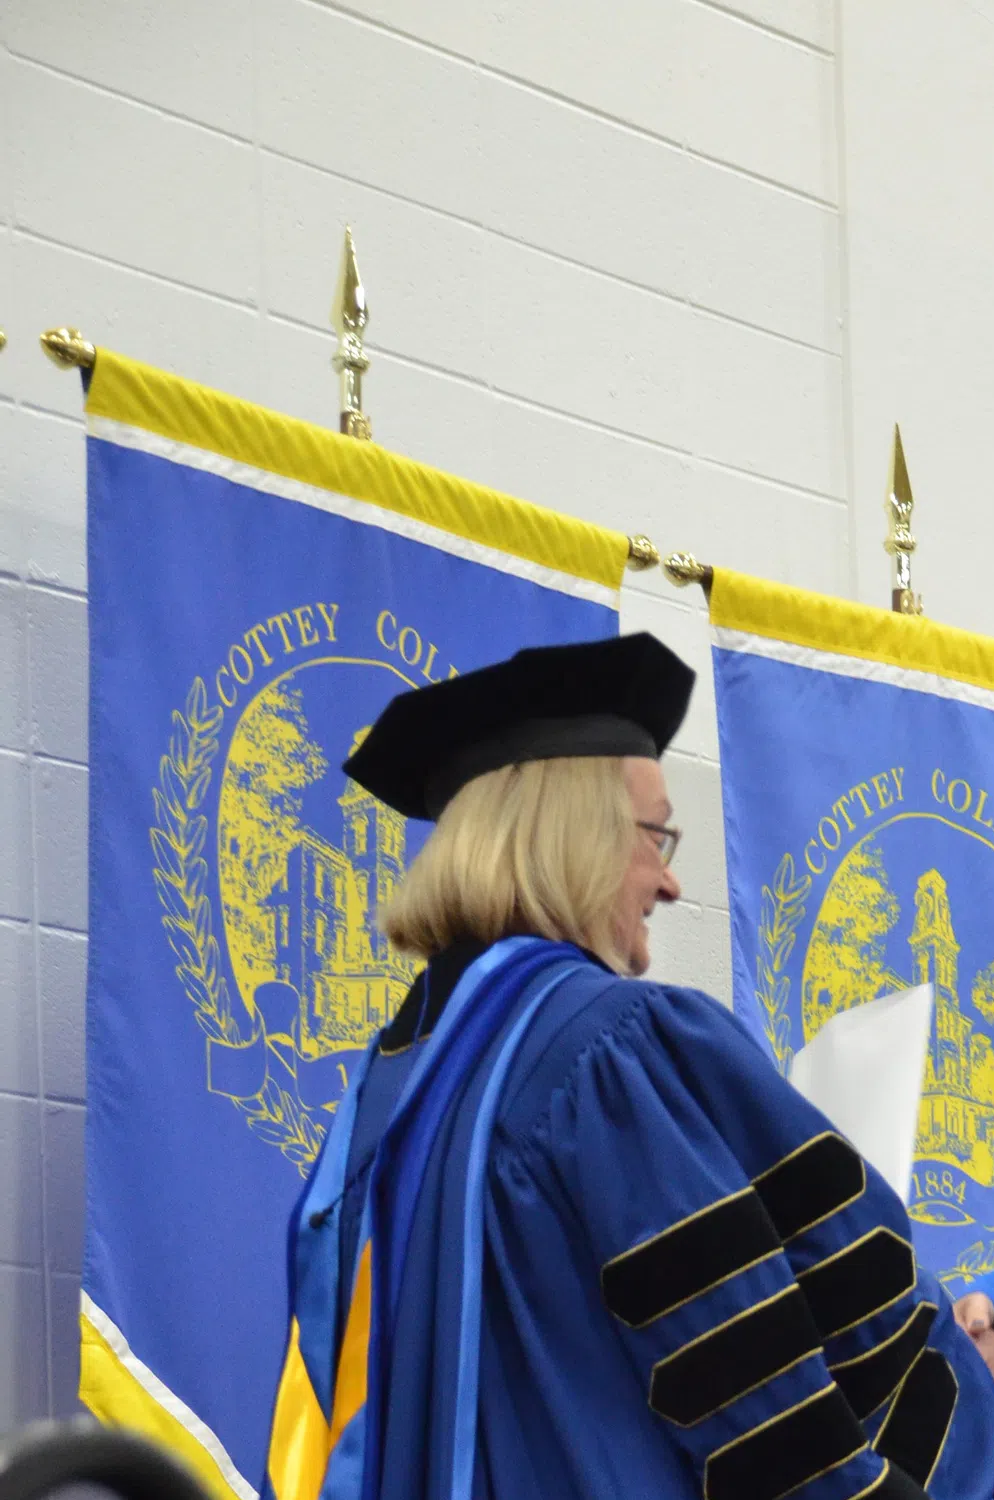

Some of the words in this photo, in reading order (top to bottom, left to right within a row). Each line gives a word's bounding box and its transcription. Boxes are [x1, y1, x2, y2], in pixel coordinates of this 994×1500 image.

[216, 602, 339, 708] COTTEY
[376, 609, 461, 684] COL
[804, 766, 905, 875] COTTEY
[912, 1169, 967, 1205] 1884
